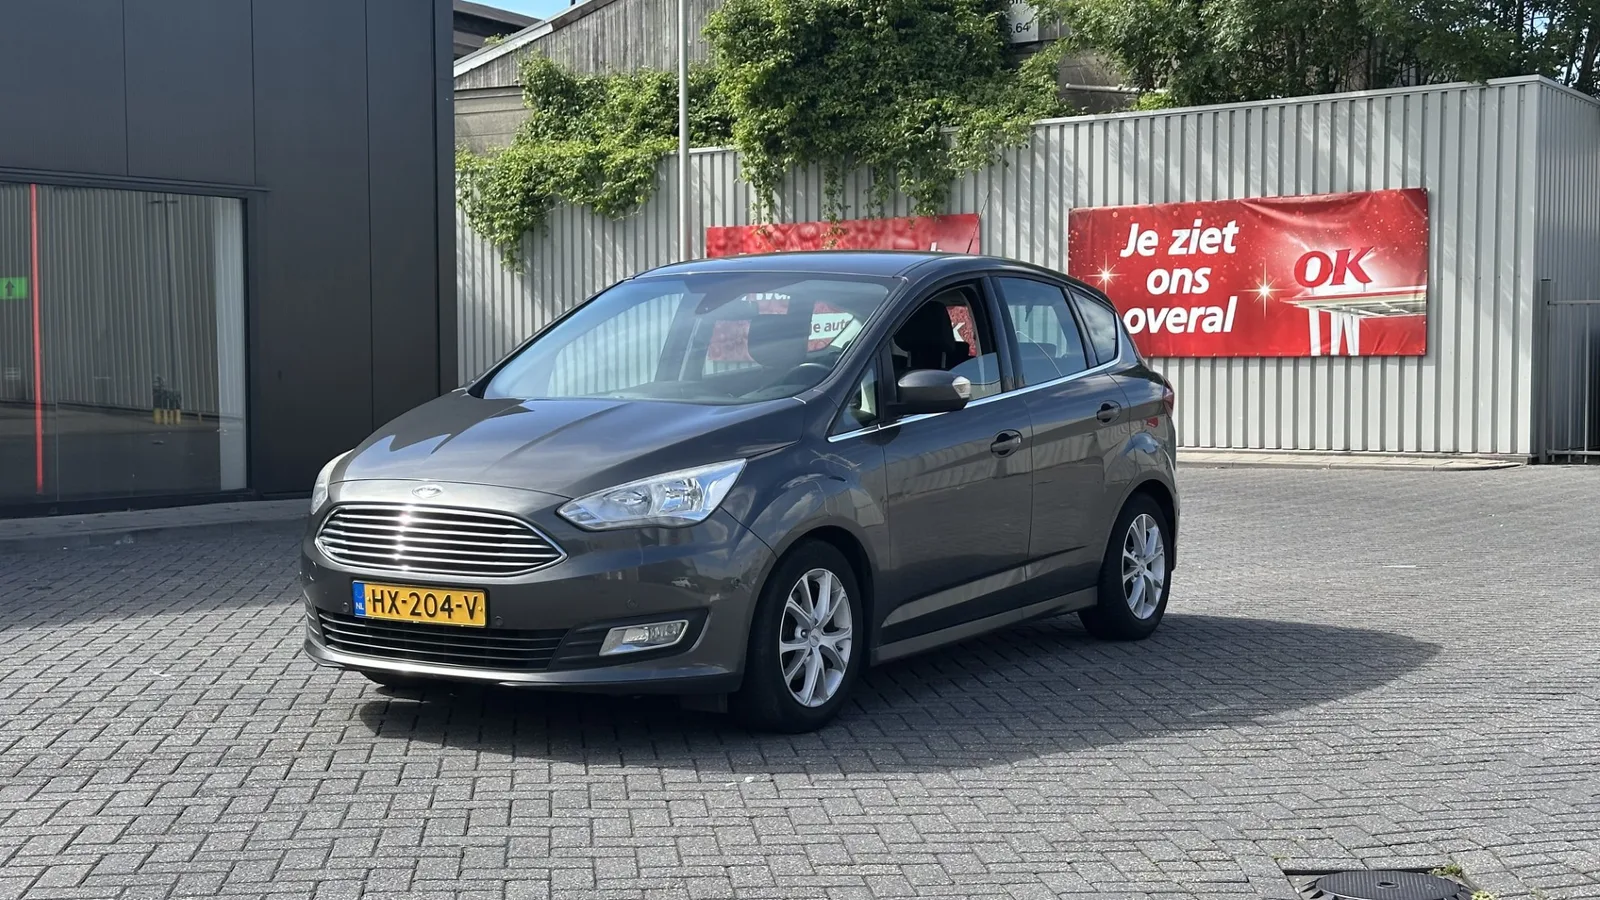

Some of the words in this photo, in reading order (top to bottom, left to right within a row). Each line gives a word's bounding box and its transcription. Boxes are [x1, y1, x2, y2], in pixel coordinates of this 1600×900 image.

[1120, 223, 1159, 257] Je
[1168, 219, 1239, 255] ziet
[1147, 266, 1211, 295] ons
[1294, 246, 1374, 287] OK
[1124, 296, 1237, 334] overal
[355, 601, 364, 610] NL
[371, 588, 478, 620] HX-204-V
